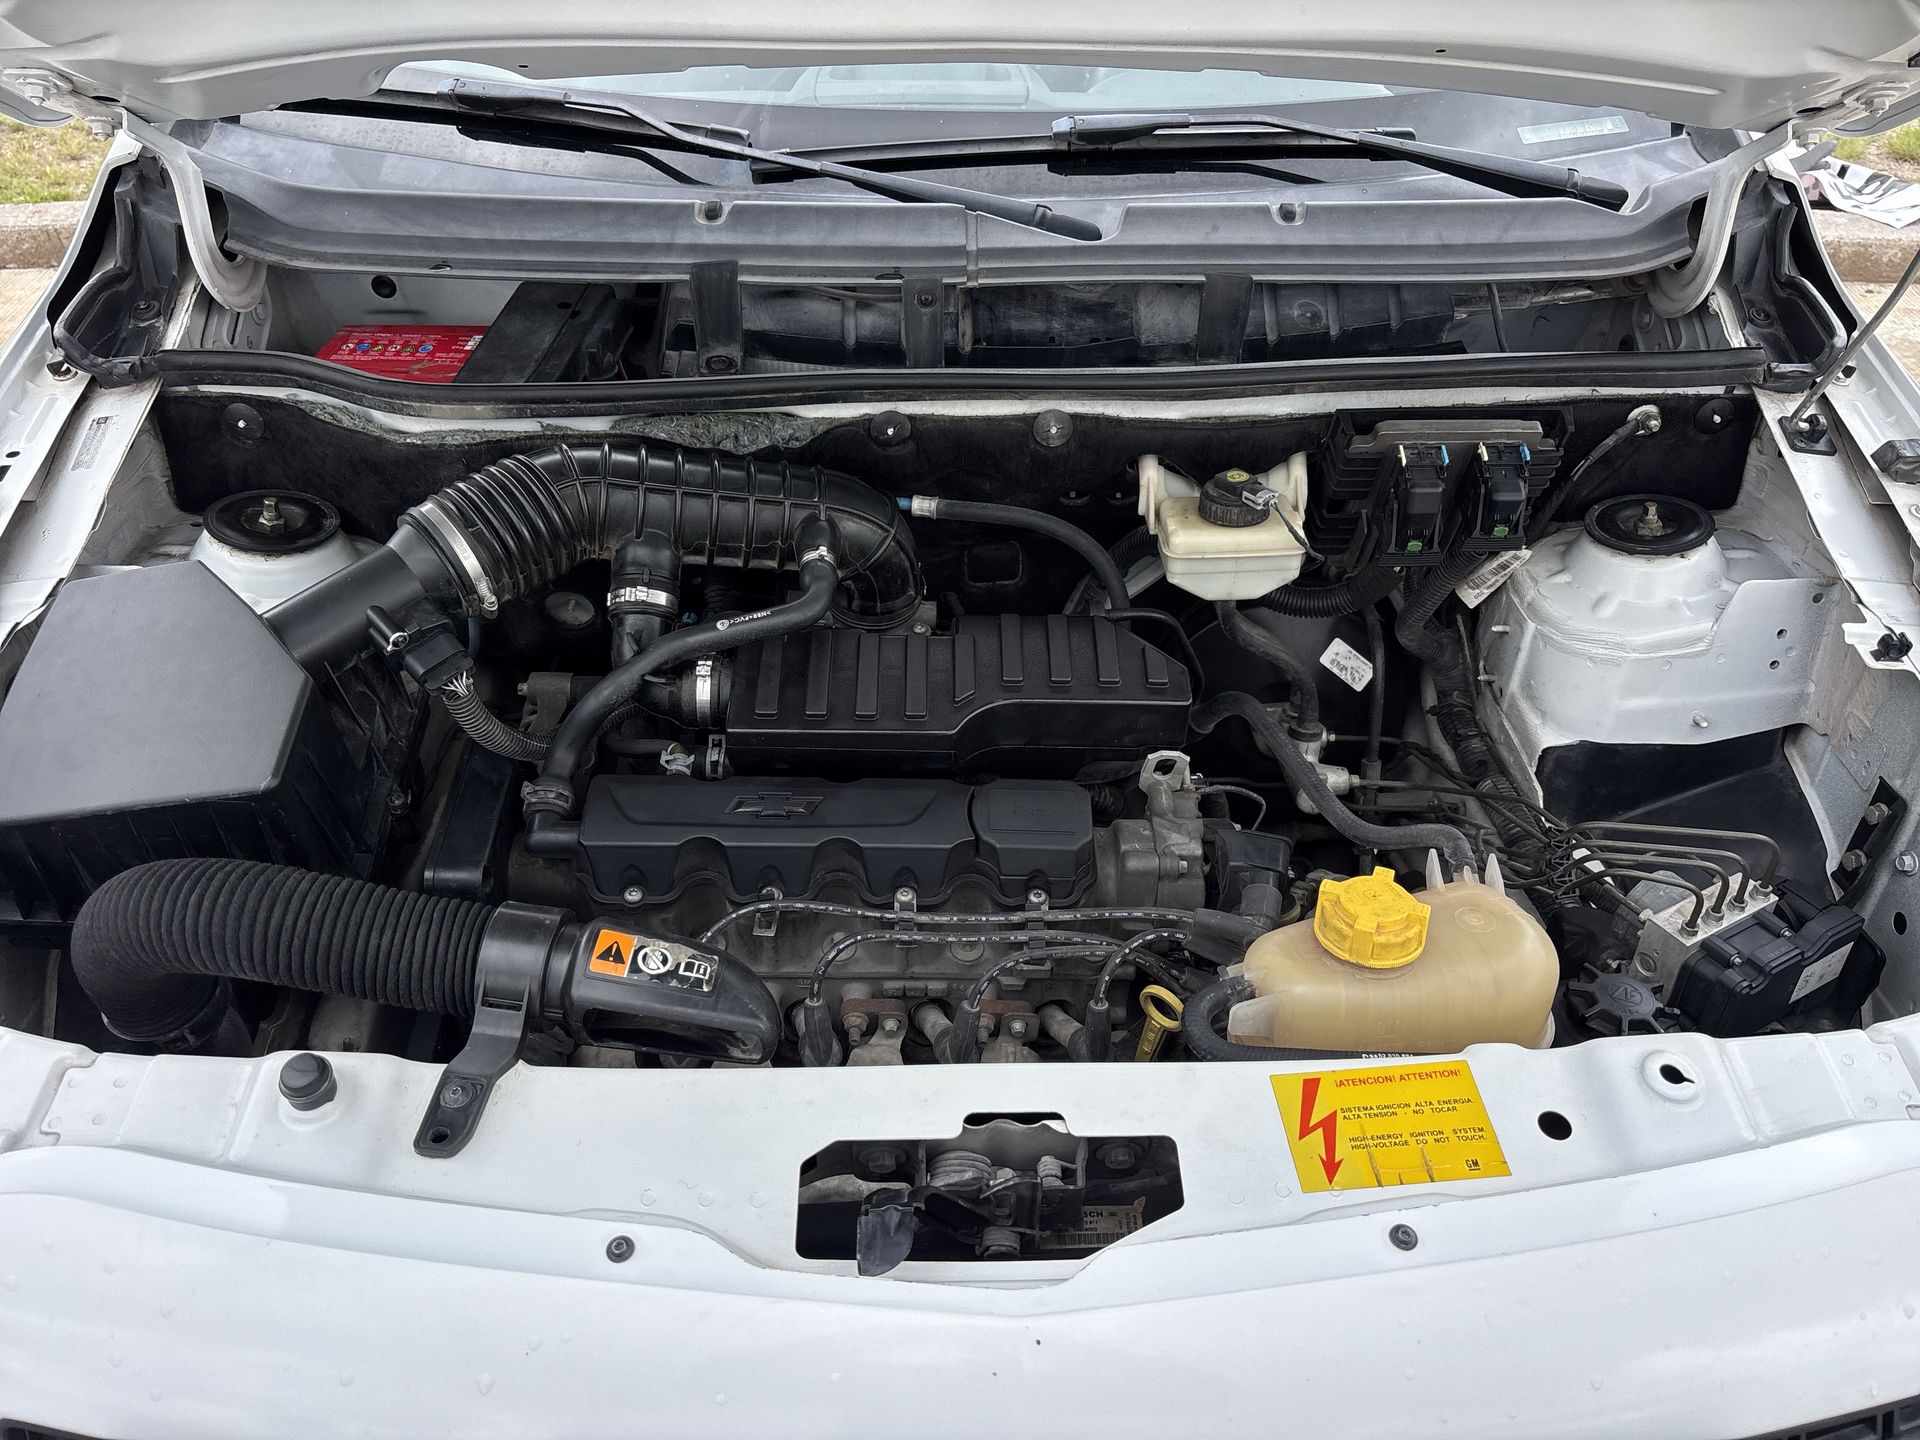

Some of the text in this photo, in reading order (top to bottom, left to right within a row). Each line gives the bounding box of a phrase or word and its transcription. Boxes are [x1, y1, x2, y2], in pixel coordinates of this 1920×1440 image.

[1335, 1069, 1461, 1088] ¡ATENCION! ATTENTION!
[1340, 1104, 1374, 1114] SISTEMA
[1375, 1102, 1411, 1111] IGNICION
[1414, 1100, 1434, 1108] ALTA
[1342, 1112, 1362, 1121] ALTA
[1364, 1110, 1398, 1119] TENSION
[1412, 1108, 1425, 1116] NO
[1430, 1105, 1459, 1114] TOCAR
[1349, 1132, 1404, 1143] HIGH-ENERGY
[1409, 1129, 1445, 1138] IGNITION
[1351, 1140, 1410, 1151] HIGH-VOLTAGE
[1415, 1138, 1428, 1146] DO
[1434, 1136, 1450, 1144] NOT
[1465, 1158, 1480, 1169] GM
